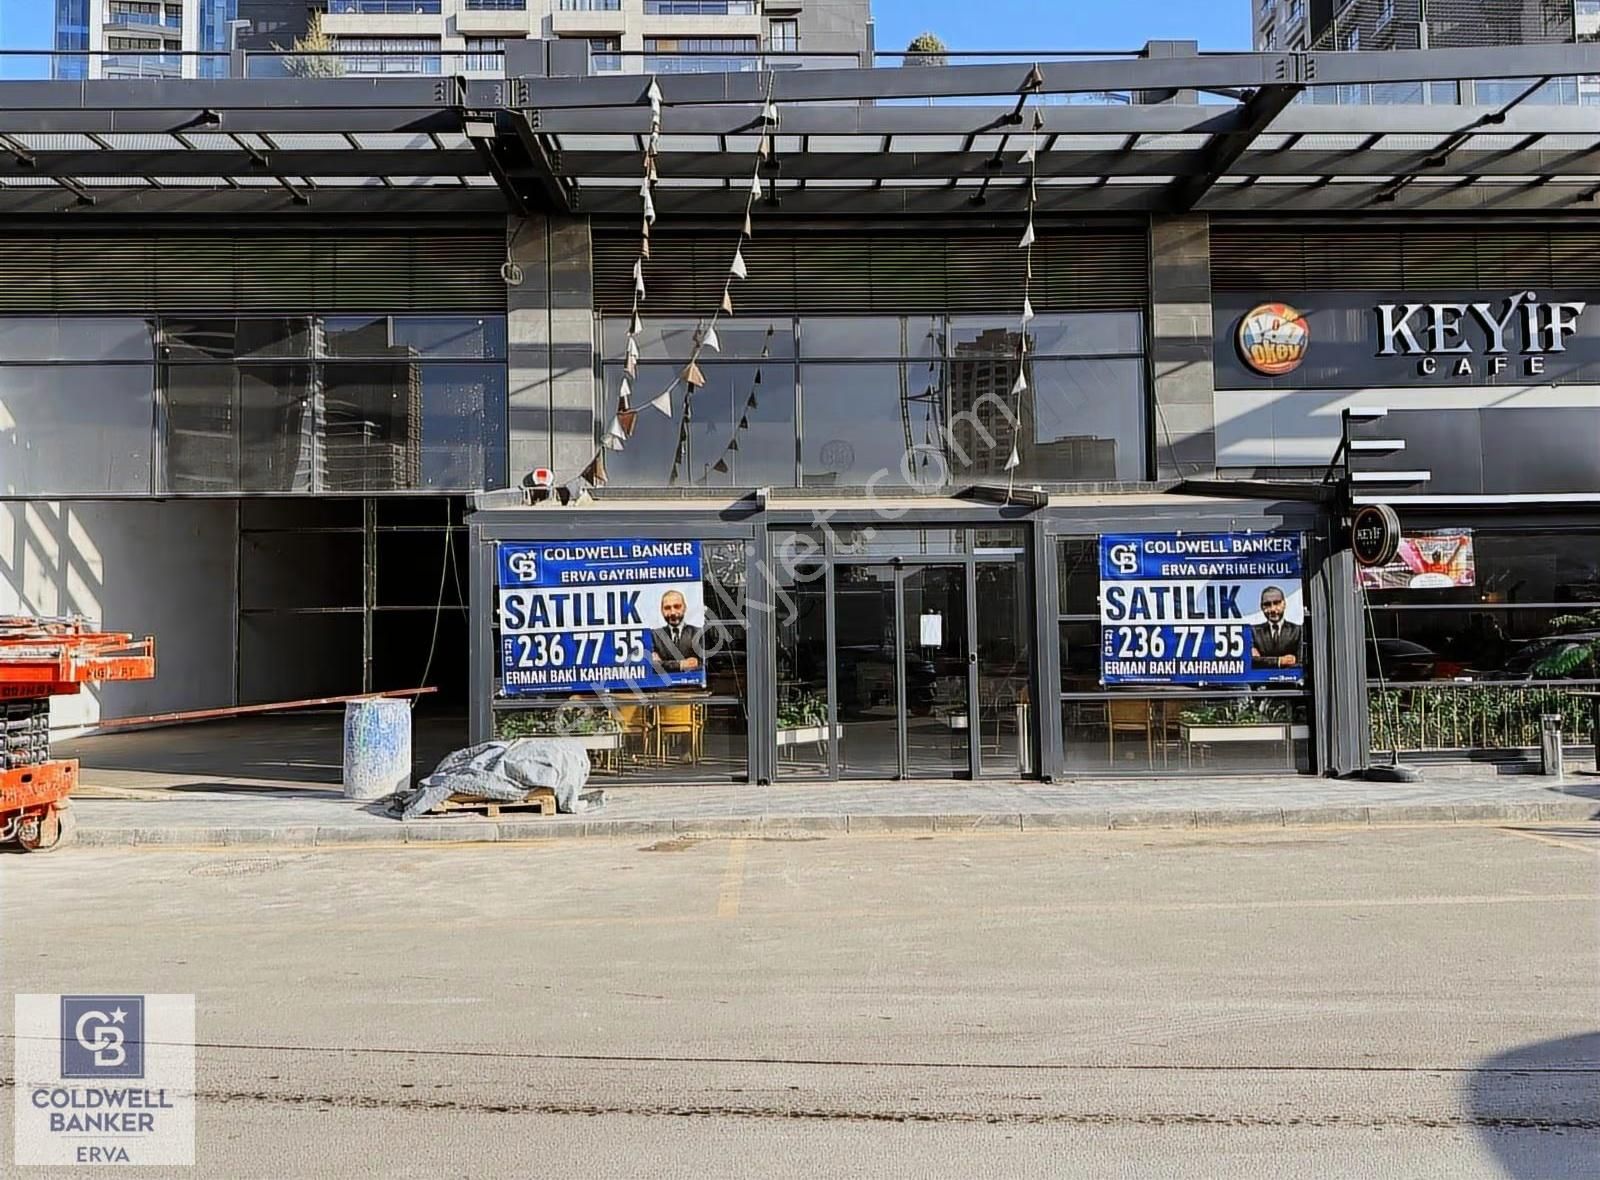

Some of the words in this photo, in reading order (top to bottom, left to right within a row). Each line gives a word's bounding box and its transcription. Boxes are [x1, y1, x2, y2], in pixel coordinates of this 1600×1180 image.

[1376, 291, 1586, 355] KEYİF
[1422, 357, 1546, 375] CAFE
[544, 546, 628, 561] COLDWELL
[632, 542, 693, 557] BANKER
[1145, 540, 1228, 554] COLDWELL
[1233, 539, 1293, 553] BANKER
[561, 570, 596, 582] ERVA
[1161, 564, 1196, 576] ERVA
[504, 590, 642, 630] SATILIK
[1105, 585, 1242, 620] SATILIK
[518, 634, 564, 668] 236
[573, 632, 605, 665] 77
[614, 631, 644, 664] 55
[1118, 626, 1164, 658] 236
[1174, 626, 1205, 658] 77
[1214, 625, 1244, 657] 55
[506, 670, 547, 685] ERMAN
[550, 666, 577, 682] BAKİ
[580, 665, 645, 682] KAHRAMAN
[1104, 661, 1146, 675] ERMAN
[1150, 658, 1176, 674] BAKİ
[1179, 660, 1244, 674] KAHRAMAN
